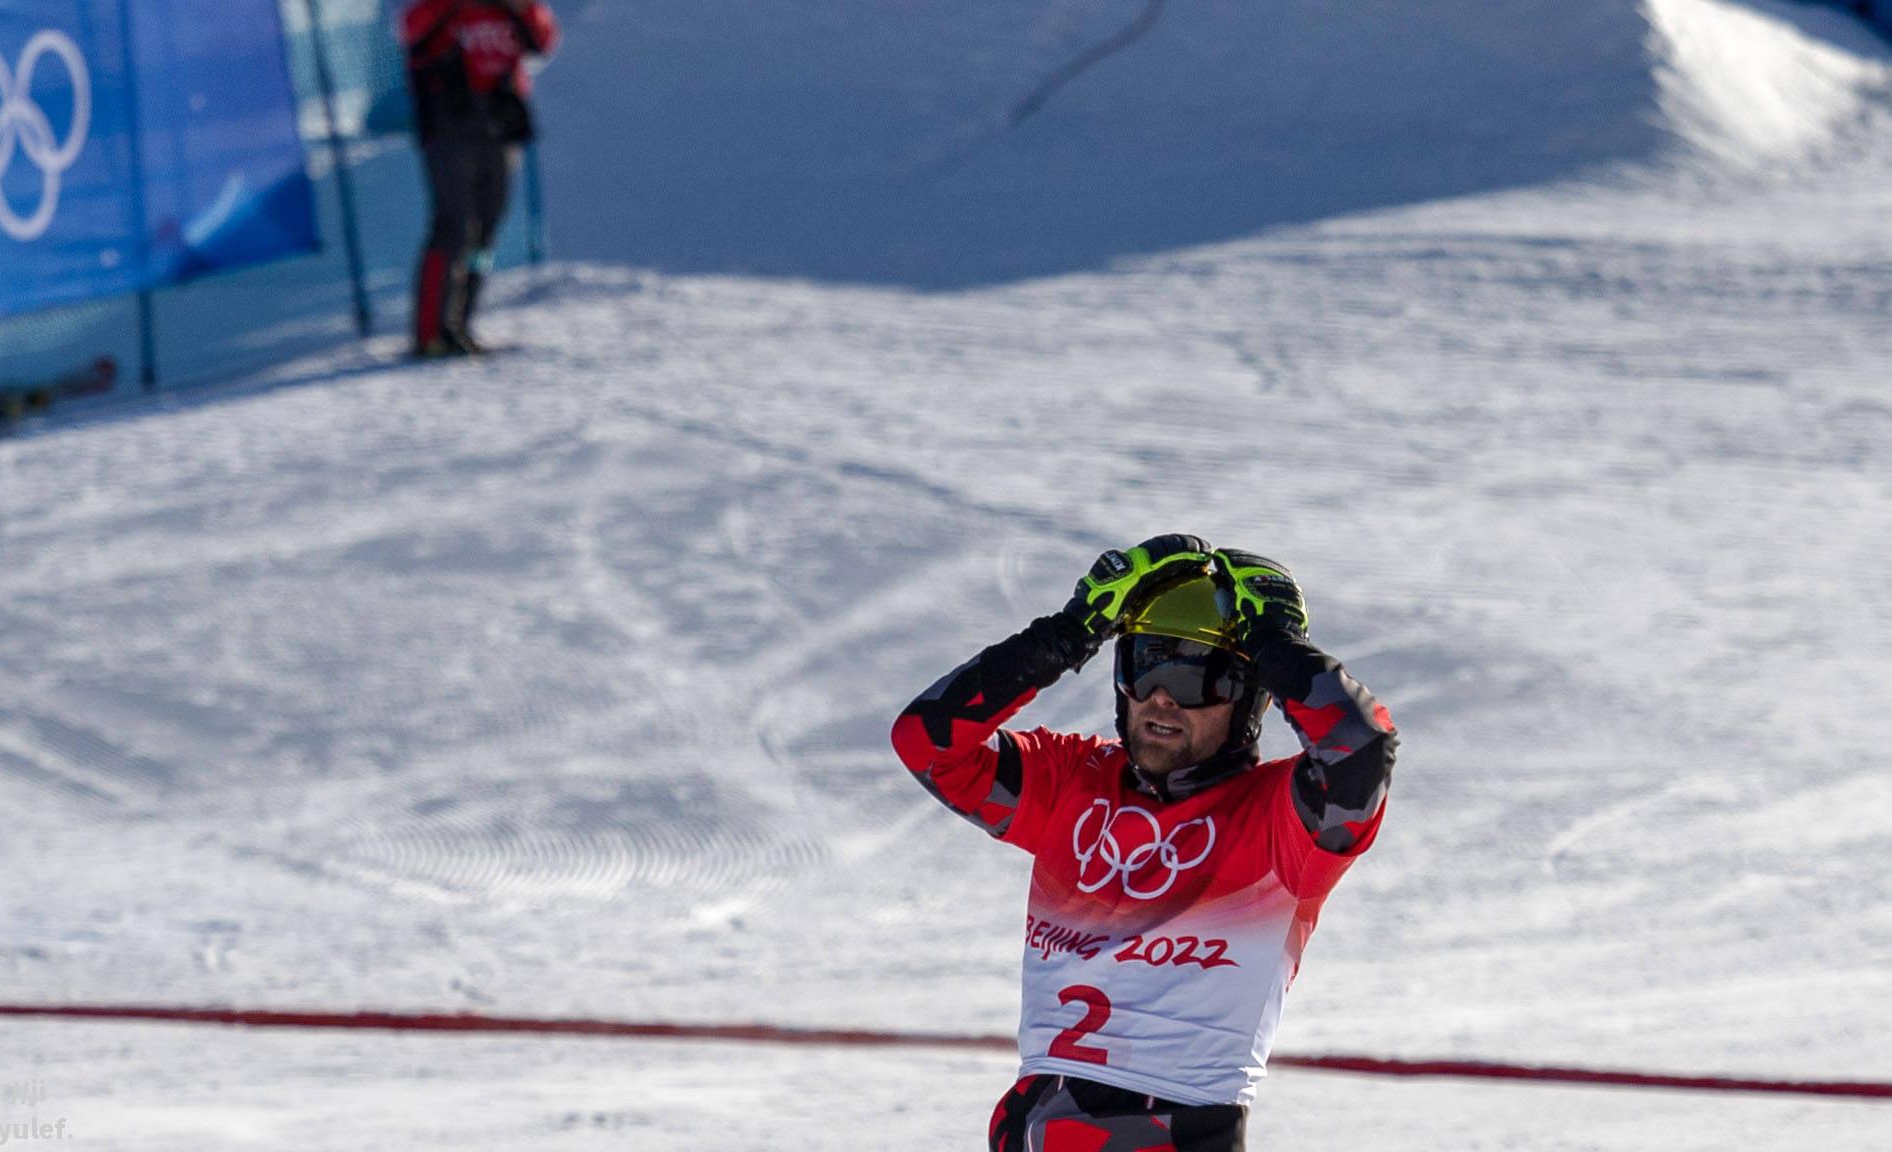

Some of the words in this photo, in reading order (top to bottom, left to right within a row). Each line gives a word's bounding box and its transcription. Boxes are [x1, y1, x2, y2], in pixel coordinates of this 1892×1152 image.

[1025, 914, 1110, 961] BEIJING
[1114, 935, 1241, 970] 2022
[1047, 984, 1112, 1066] 2
